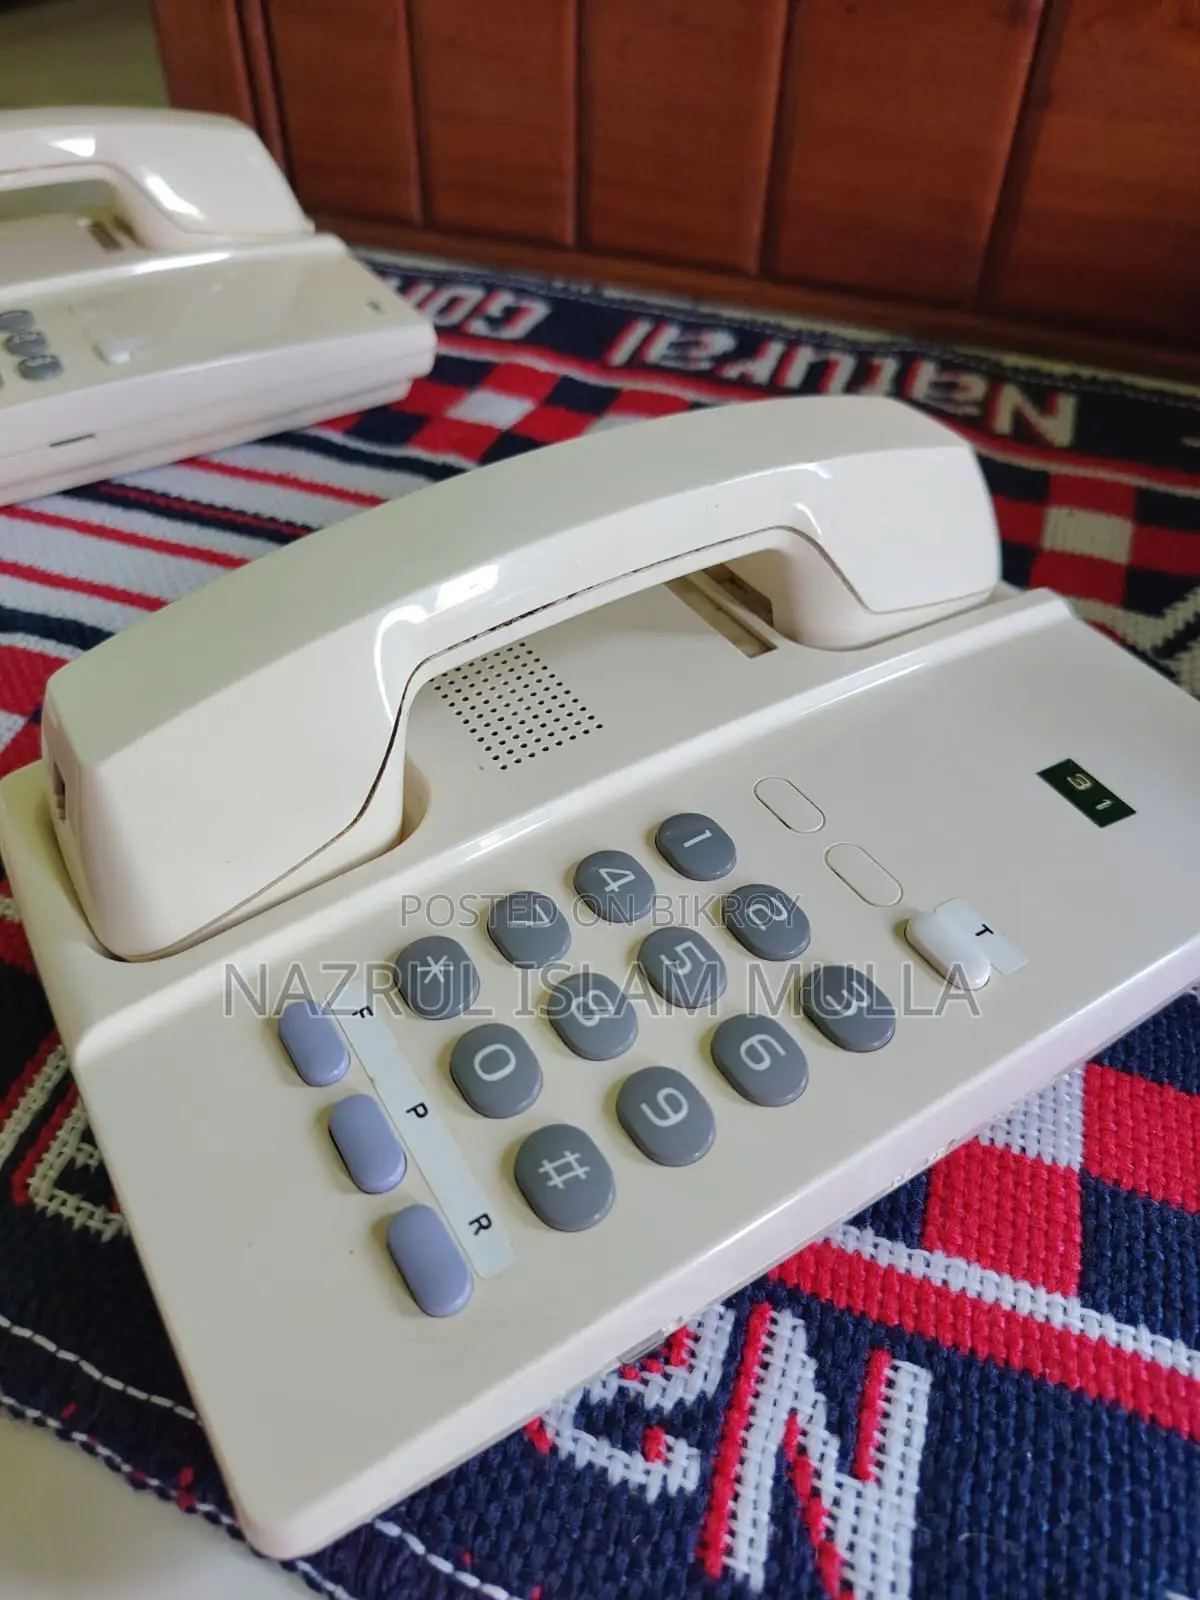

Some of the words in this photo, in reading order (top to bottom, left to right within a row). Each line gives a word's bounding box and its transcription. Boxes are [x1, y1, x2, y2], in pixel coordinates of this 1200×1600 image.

[598, 868, 636, 893] 4
[660, 940, 706, 976] 5
[739, 1033, 786, 1071] 6
[683, 829, 712, 848] 1
[745, 896, 788, 931] 2
[826, 981, 871, 1017] 3
[975, 923, 994, 938] T
[474, 1043, 516, 1081] 0
[572, 989, 615, 1027] 8
[640, 1087, 689, 1128] 9
[406, 1102, 429, 1120] P
[468, 1213, 493, 1236] R
